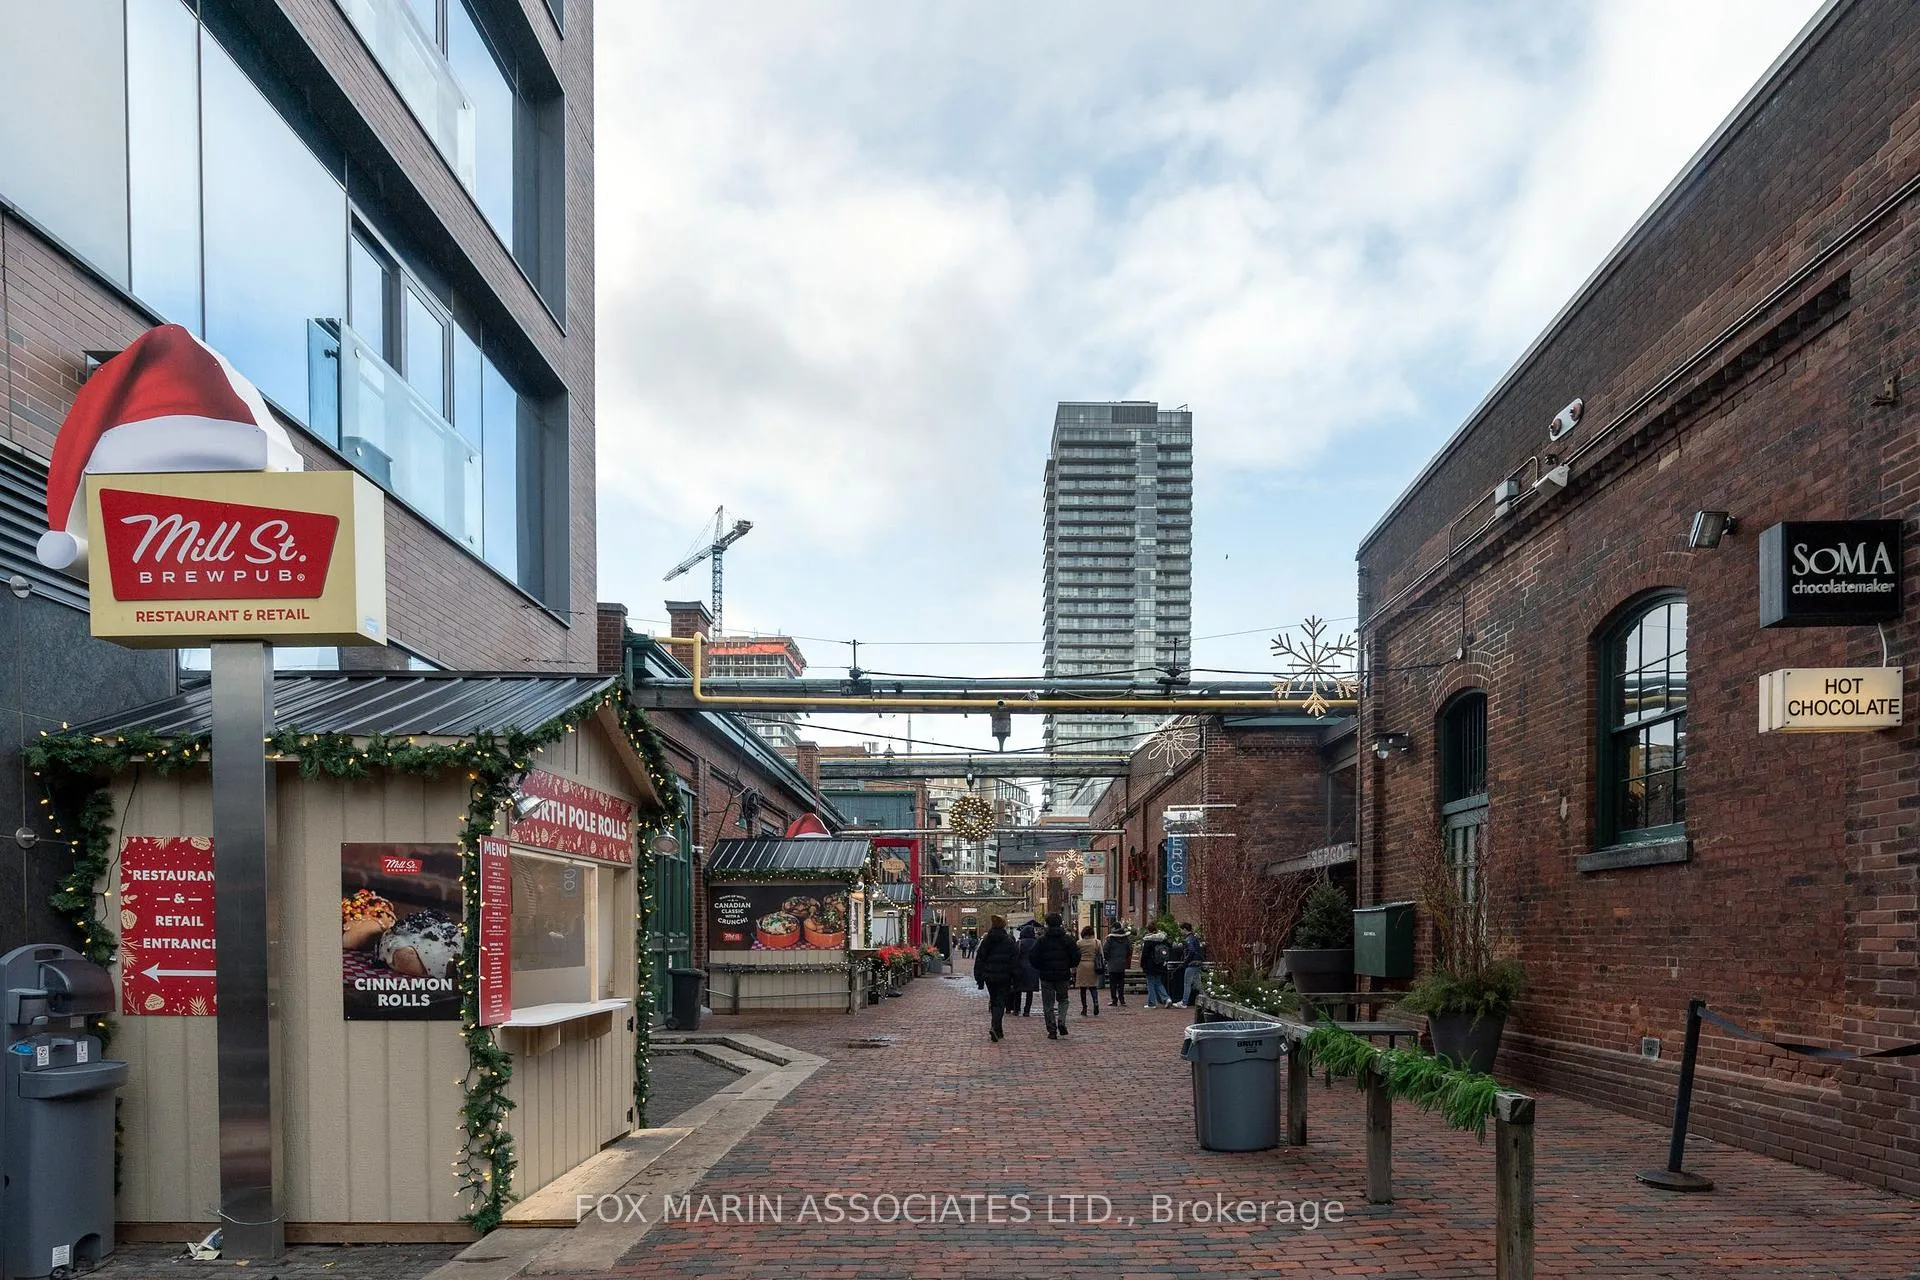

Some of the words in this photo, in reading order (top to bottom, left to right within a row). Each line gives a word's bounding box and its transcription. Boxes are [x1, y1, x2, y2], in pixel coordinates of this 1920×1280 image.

[120, 513, 241, 564] Mill
[245, 520, 307, 564] St.
[1792, 578, 1895, 594] chocolatemaker
[136, 609, 239, 623] RESTAURANT
[243, 609, 252, 621] &
[256, 608, 310, 621] RETAIL
[1825, 678, 1864, 694] HOT
[1788, 699, 1900, 716] CHOCOLATE
[531, 799, 566, 826] RTH
[568, 805, 596, 834] POLE
[598, 814, 627, 841] ROLLS
[484, 841, 508, 858] MENU
[384, 859, 406, 869] Mill
[132, 870, 215, 882] RESTAURAN
[173, 893, 185, 904] &
[155, 916, 204, 927] RETAIL
[717, 917, 748, 925] CRUNCH!
[354, 978, 453, 992] CINNAMON
[377, 994, 431, 1007] ROLLS
